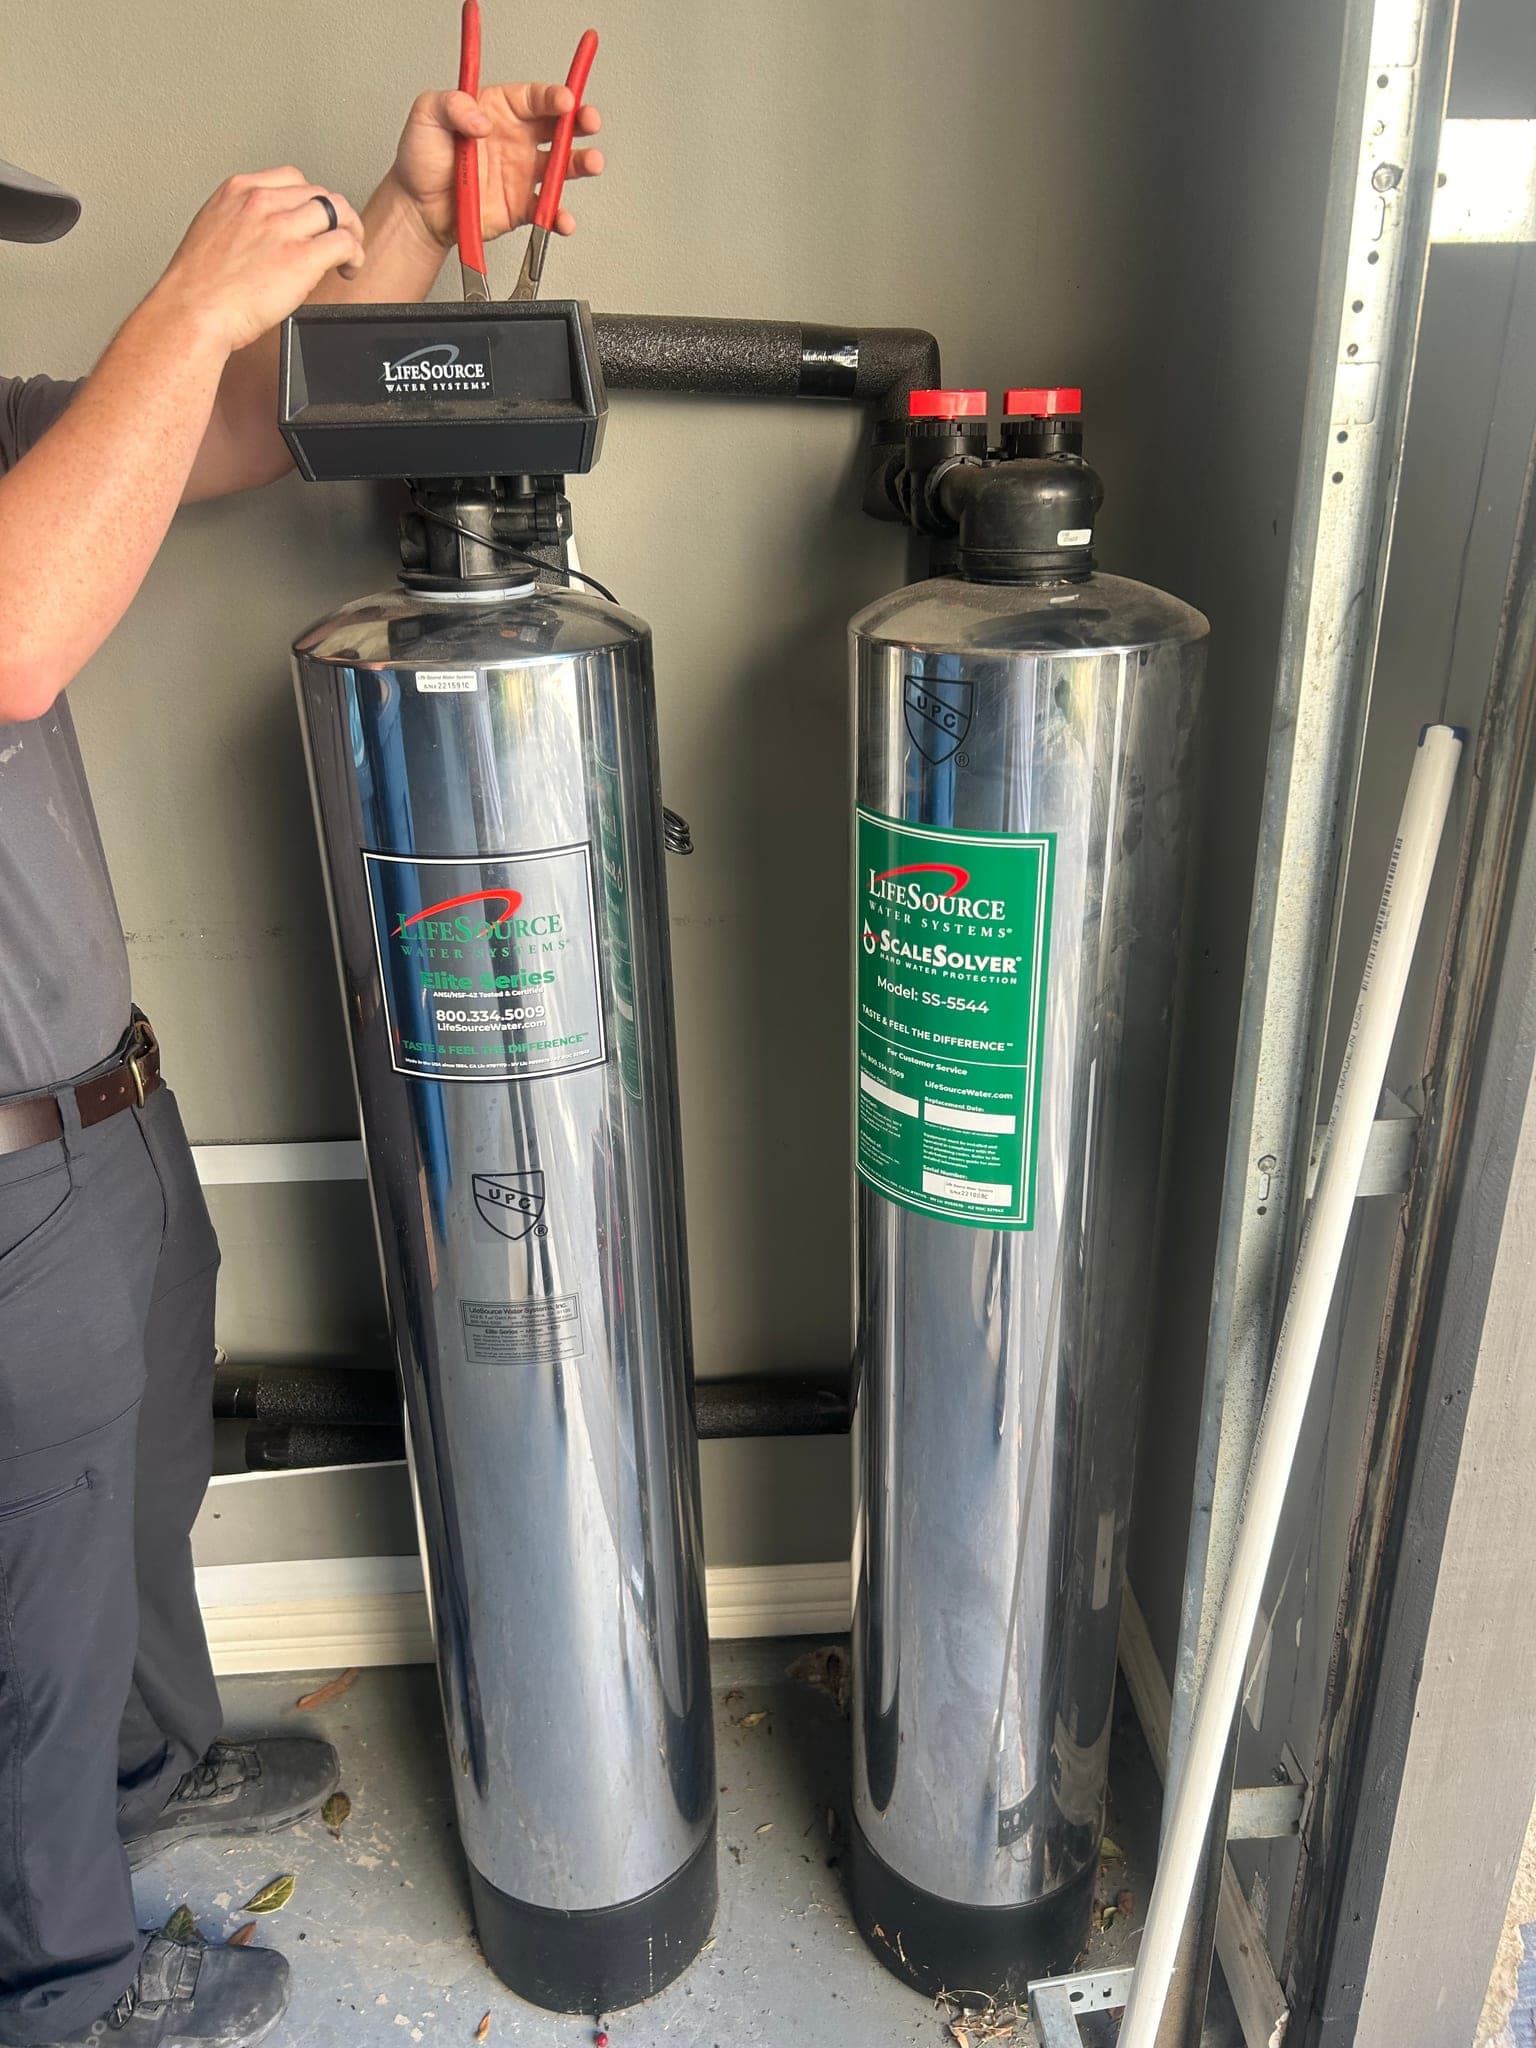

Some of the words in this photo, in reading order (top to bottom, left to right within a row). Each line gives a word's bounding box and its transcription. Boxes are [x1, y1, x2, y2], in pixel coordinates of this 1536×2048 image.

[383, 361, 485, 382] LIFESOURCE
[385, 383, 426, 393] WATER
[917, 696, 956, 728] UPC
[869, 869, 1006, 921] LIFESOURCE
[869, 900, 911, 924] WATER
[396, 912, 563, 943] LIFESOURCE
[400, 945, 464, 959] WATER
[420, 971, 473, 990] Elite
[480, 968, 555, 990] Series
[880, 952, 901, 966] HARD
[905, 961, 938, 976] WATER
[943, 970, 1017, 985] PROTECTION
[877, 976, 918, 1001] Model:
[922, 992, 990, 1014] SS-5544
[436, 1006, 545, 1022] 800.334.5009
[862, 1004, 881, 1023] TASTE
[882, 1016, 888, 1026] &
[889, 1020, 910, 1034] FEEL
[911, 1028, 931, 1041] THE
[437, 1020, 547, 1032] LifeSourceWater.com
[402, 1040, 435, 1053] TASTE
[448, 1046, 479, 1055] FEEL
[482, 1045, 505, 1054] THE
[887, 1047, 898, 1057] For
[898, 1053, 935, 1069] Customer
[936, 1063, 968, 1076] Service
[924, 1080, 1013, 1100] LifeSourceWater.com
[489, 1189, 531, 1210] UPC
[555, 1302, 567, 1310] Inc.
